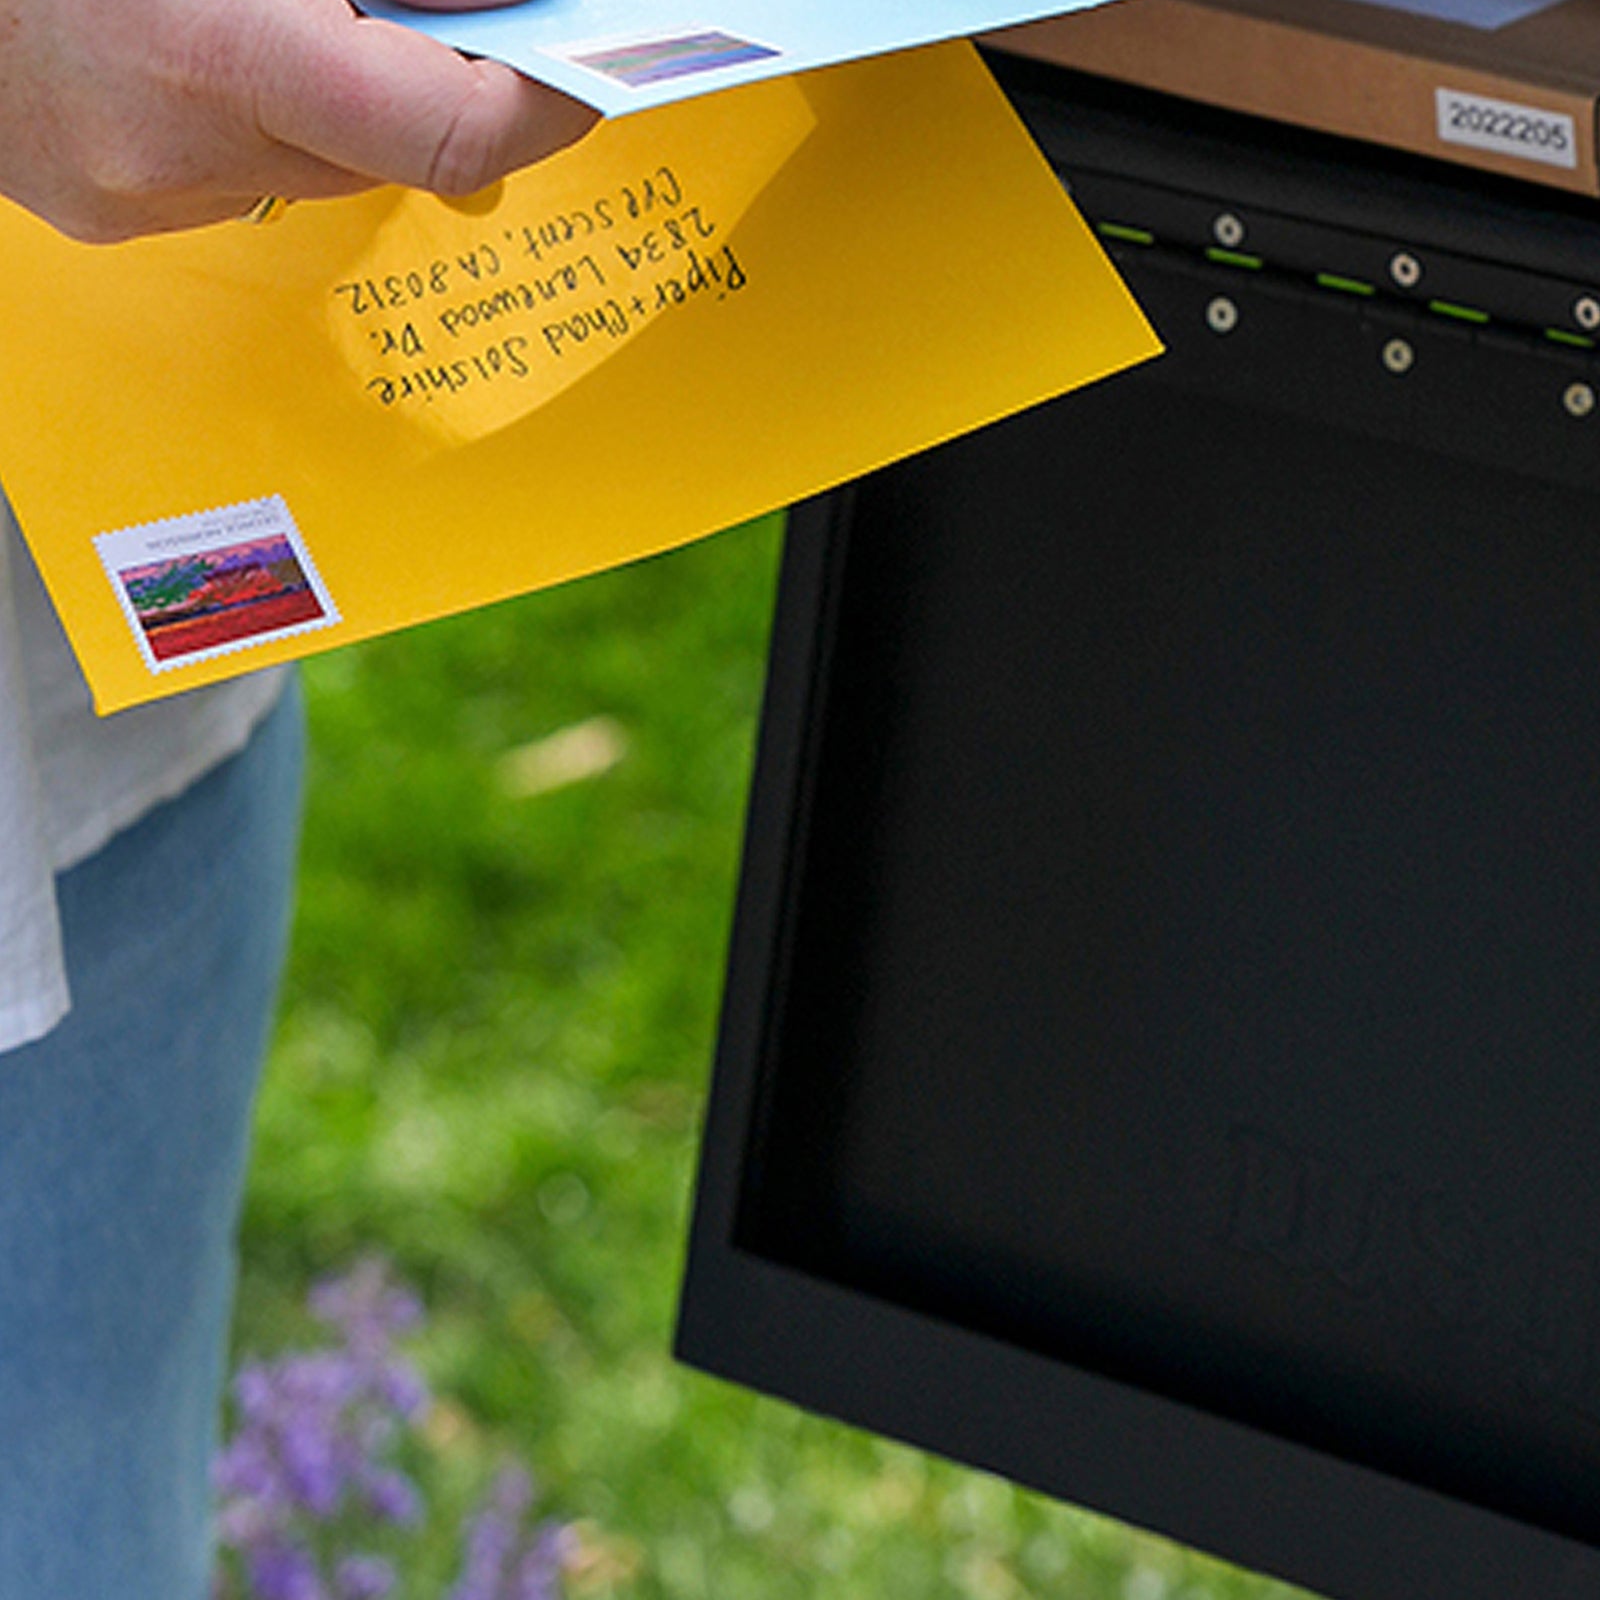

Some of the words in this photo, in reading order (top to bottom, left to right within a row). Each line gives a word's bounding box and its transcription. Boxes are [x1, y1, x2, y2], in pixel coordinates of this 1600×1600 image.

[1449, 101, 1568, 150] 2022205
[456, 242, 501, 282] CA
[615, 206, 715, 271] 2834
[334, 259, 449, 315] 80312
[438, 254, 607, 338] Lanewood
[369, 321, 425, 358] Dr.
